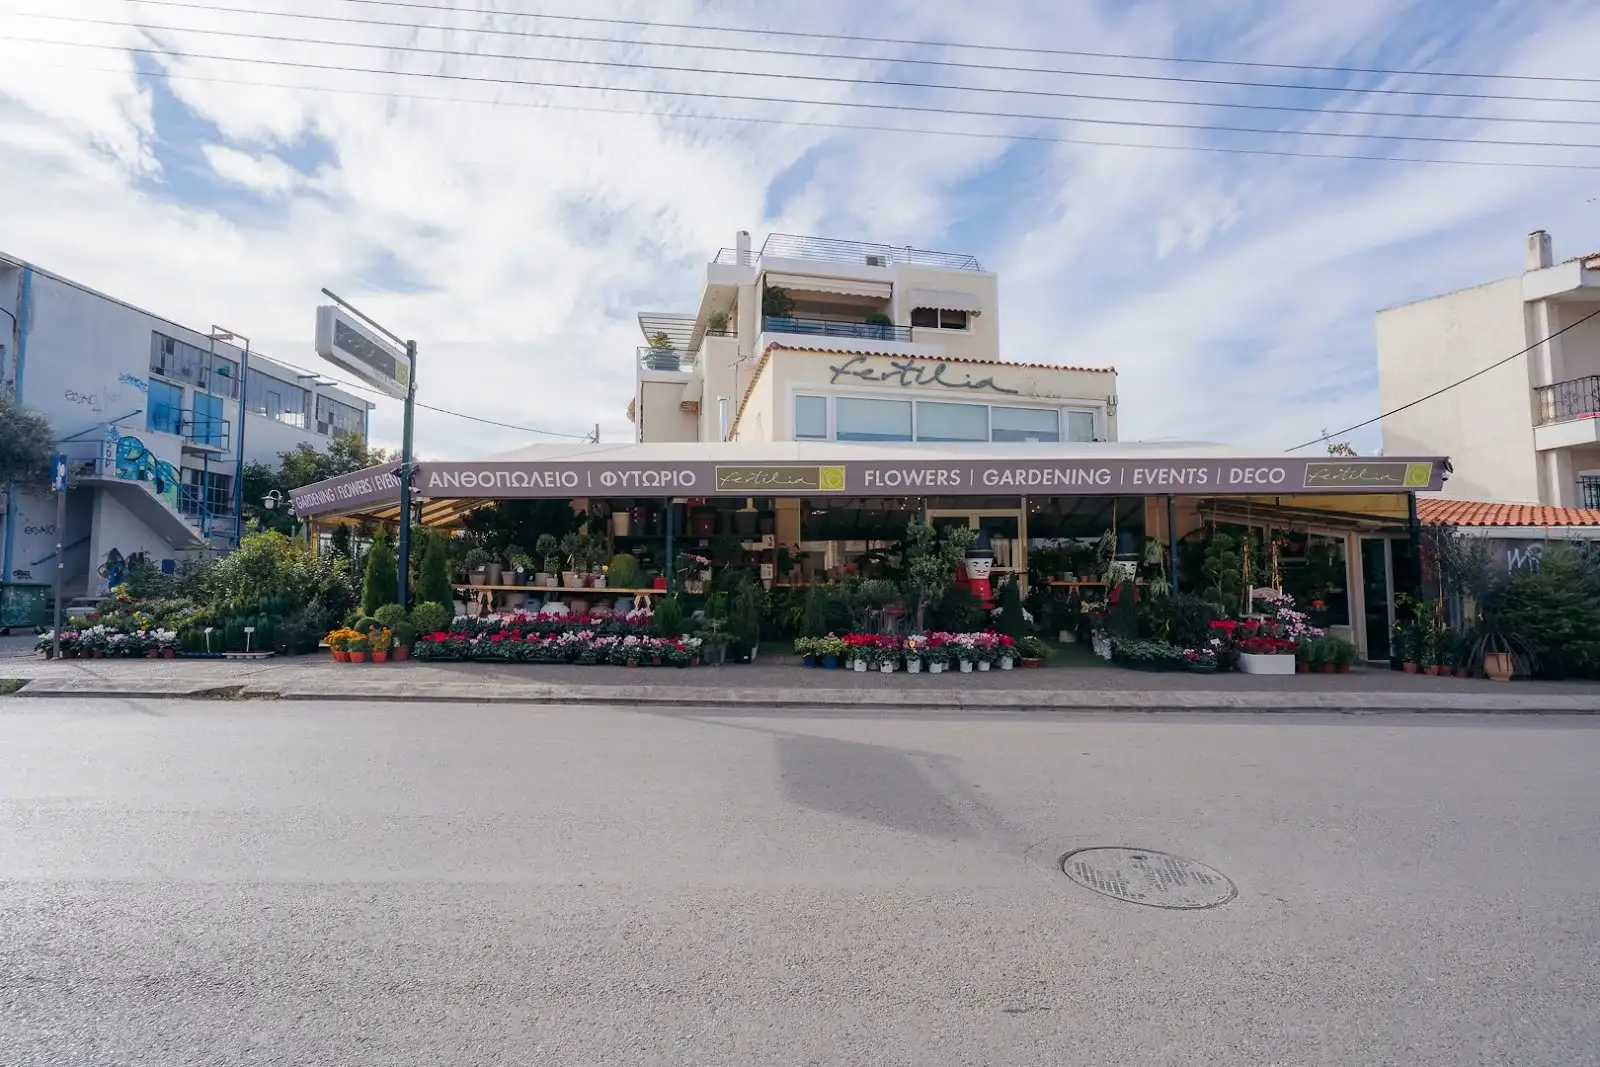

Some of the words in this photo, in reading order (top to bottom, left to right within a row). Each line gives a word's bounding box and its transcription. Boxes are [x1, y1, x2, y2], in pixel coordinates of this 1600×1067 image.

[830, 356, 1018, 393] fertilia
[428, 471, 579, 488] ΑΝΘΟΠΩΛΕΙΟ
[600, 470, 696, 487] ΦΥΤΩΡΙΟ
[720, 470, 817, 487] fertilia
[864, 469, 961, 486] FLOWERS
[983, 468, 1112, 486] GARDENING
[1133, 467, 1208, 485] EVENTS
[1229, 467, 1286, 484] DECO
[1308, 466, 1402, 483] fertilia
[295, 488, 336, 510] GARDENING
[339, 478, 372, 500] FLOWERS
